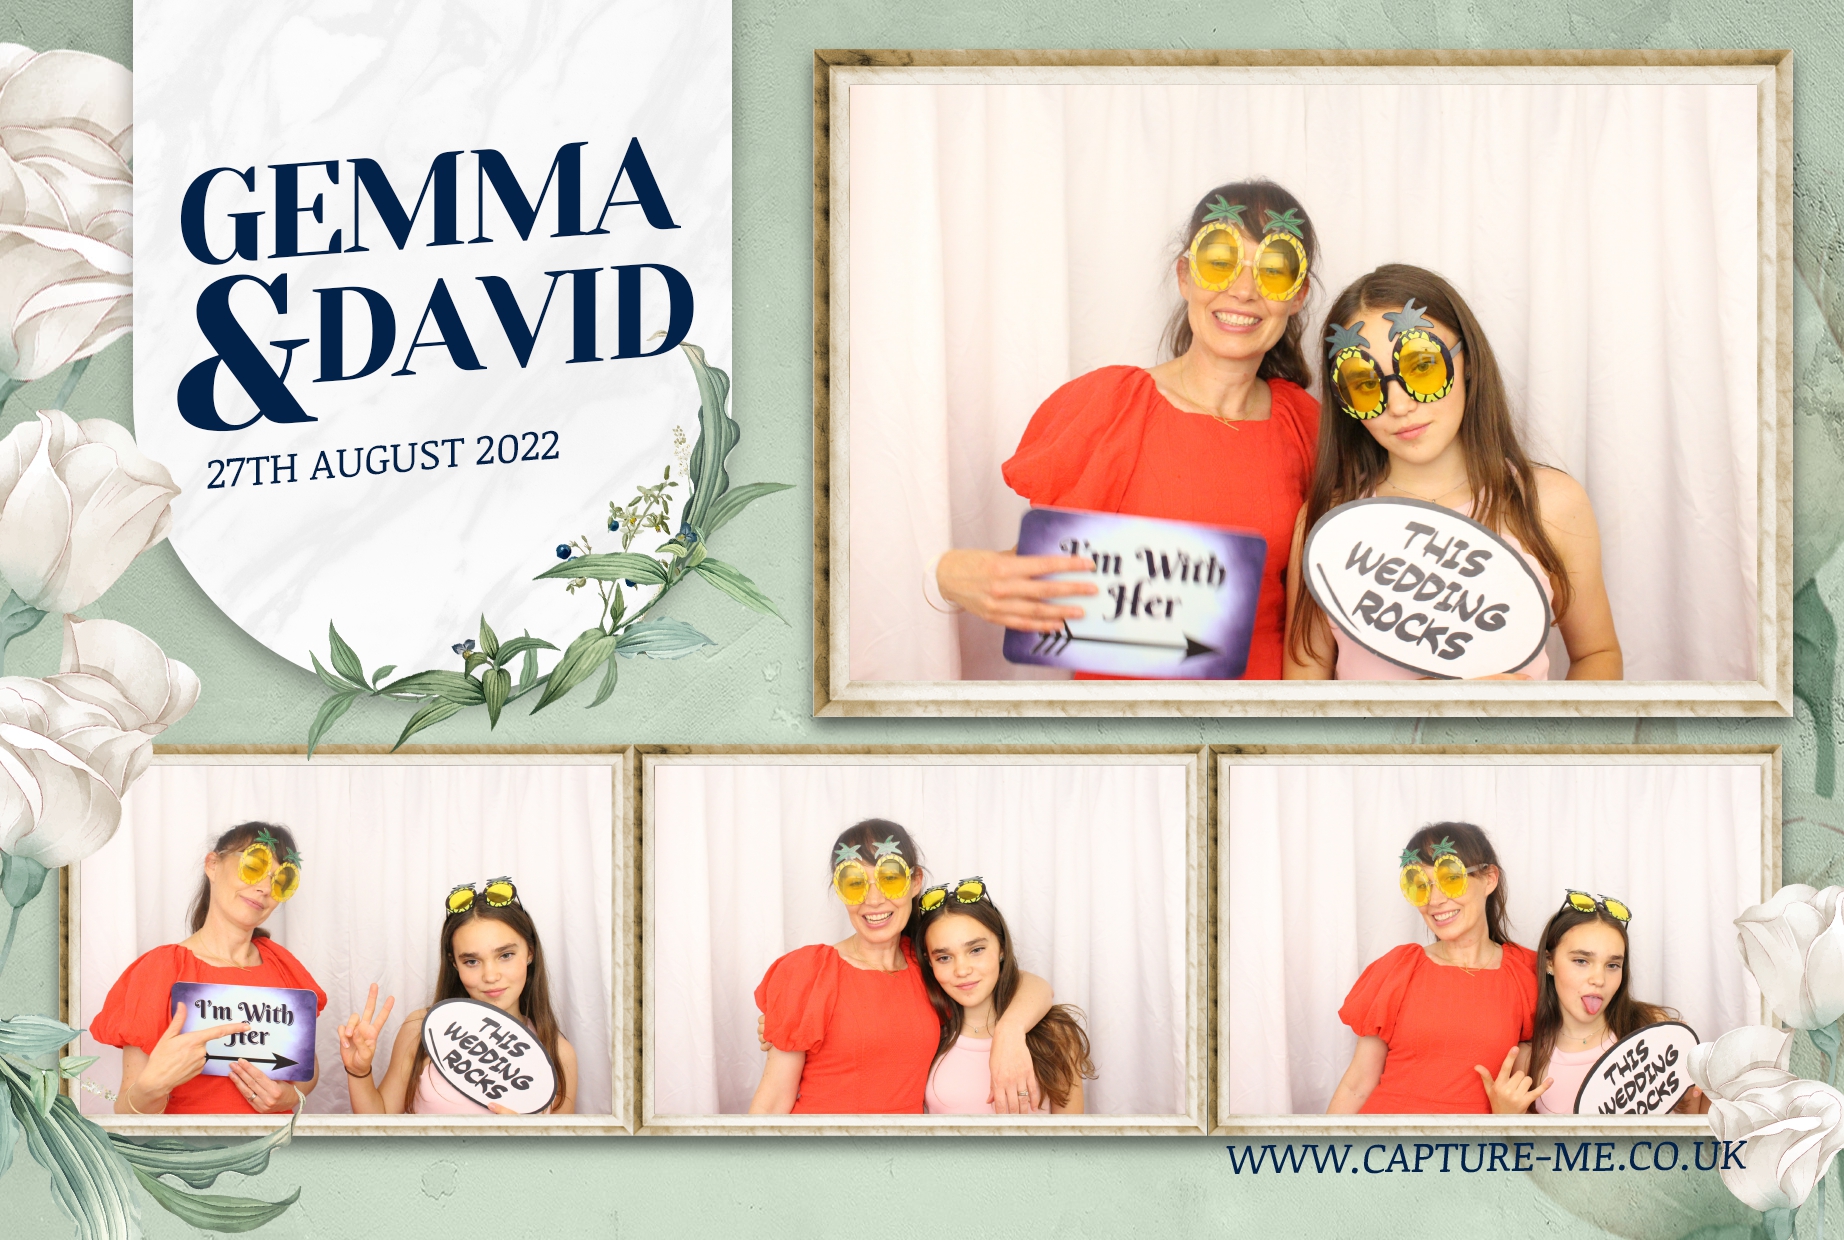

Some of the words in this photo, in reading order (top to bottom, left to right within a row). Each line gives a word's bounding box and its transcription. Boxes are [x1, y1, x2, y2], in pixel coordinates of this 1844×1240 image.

[1135, 546, 1227, 590] With
[1403, 521, 1493, 578] THIS
[1103, 578, 1182, 622] Her
[1345, 541, 1511, 632] WEDDING
[1352, 589, 1474, 661] ROCKS
[195, 999, 233, 1021] I'm
[237, 1001, 295, 1027] With
[479, 1017, 531, 1057] THIS
[442, 1049, 508, 1100] ROCKS
[443, 1021, 534, 1091] WEDDING
[1603, 1039, 1649, 1086] THIS
